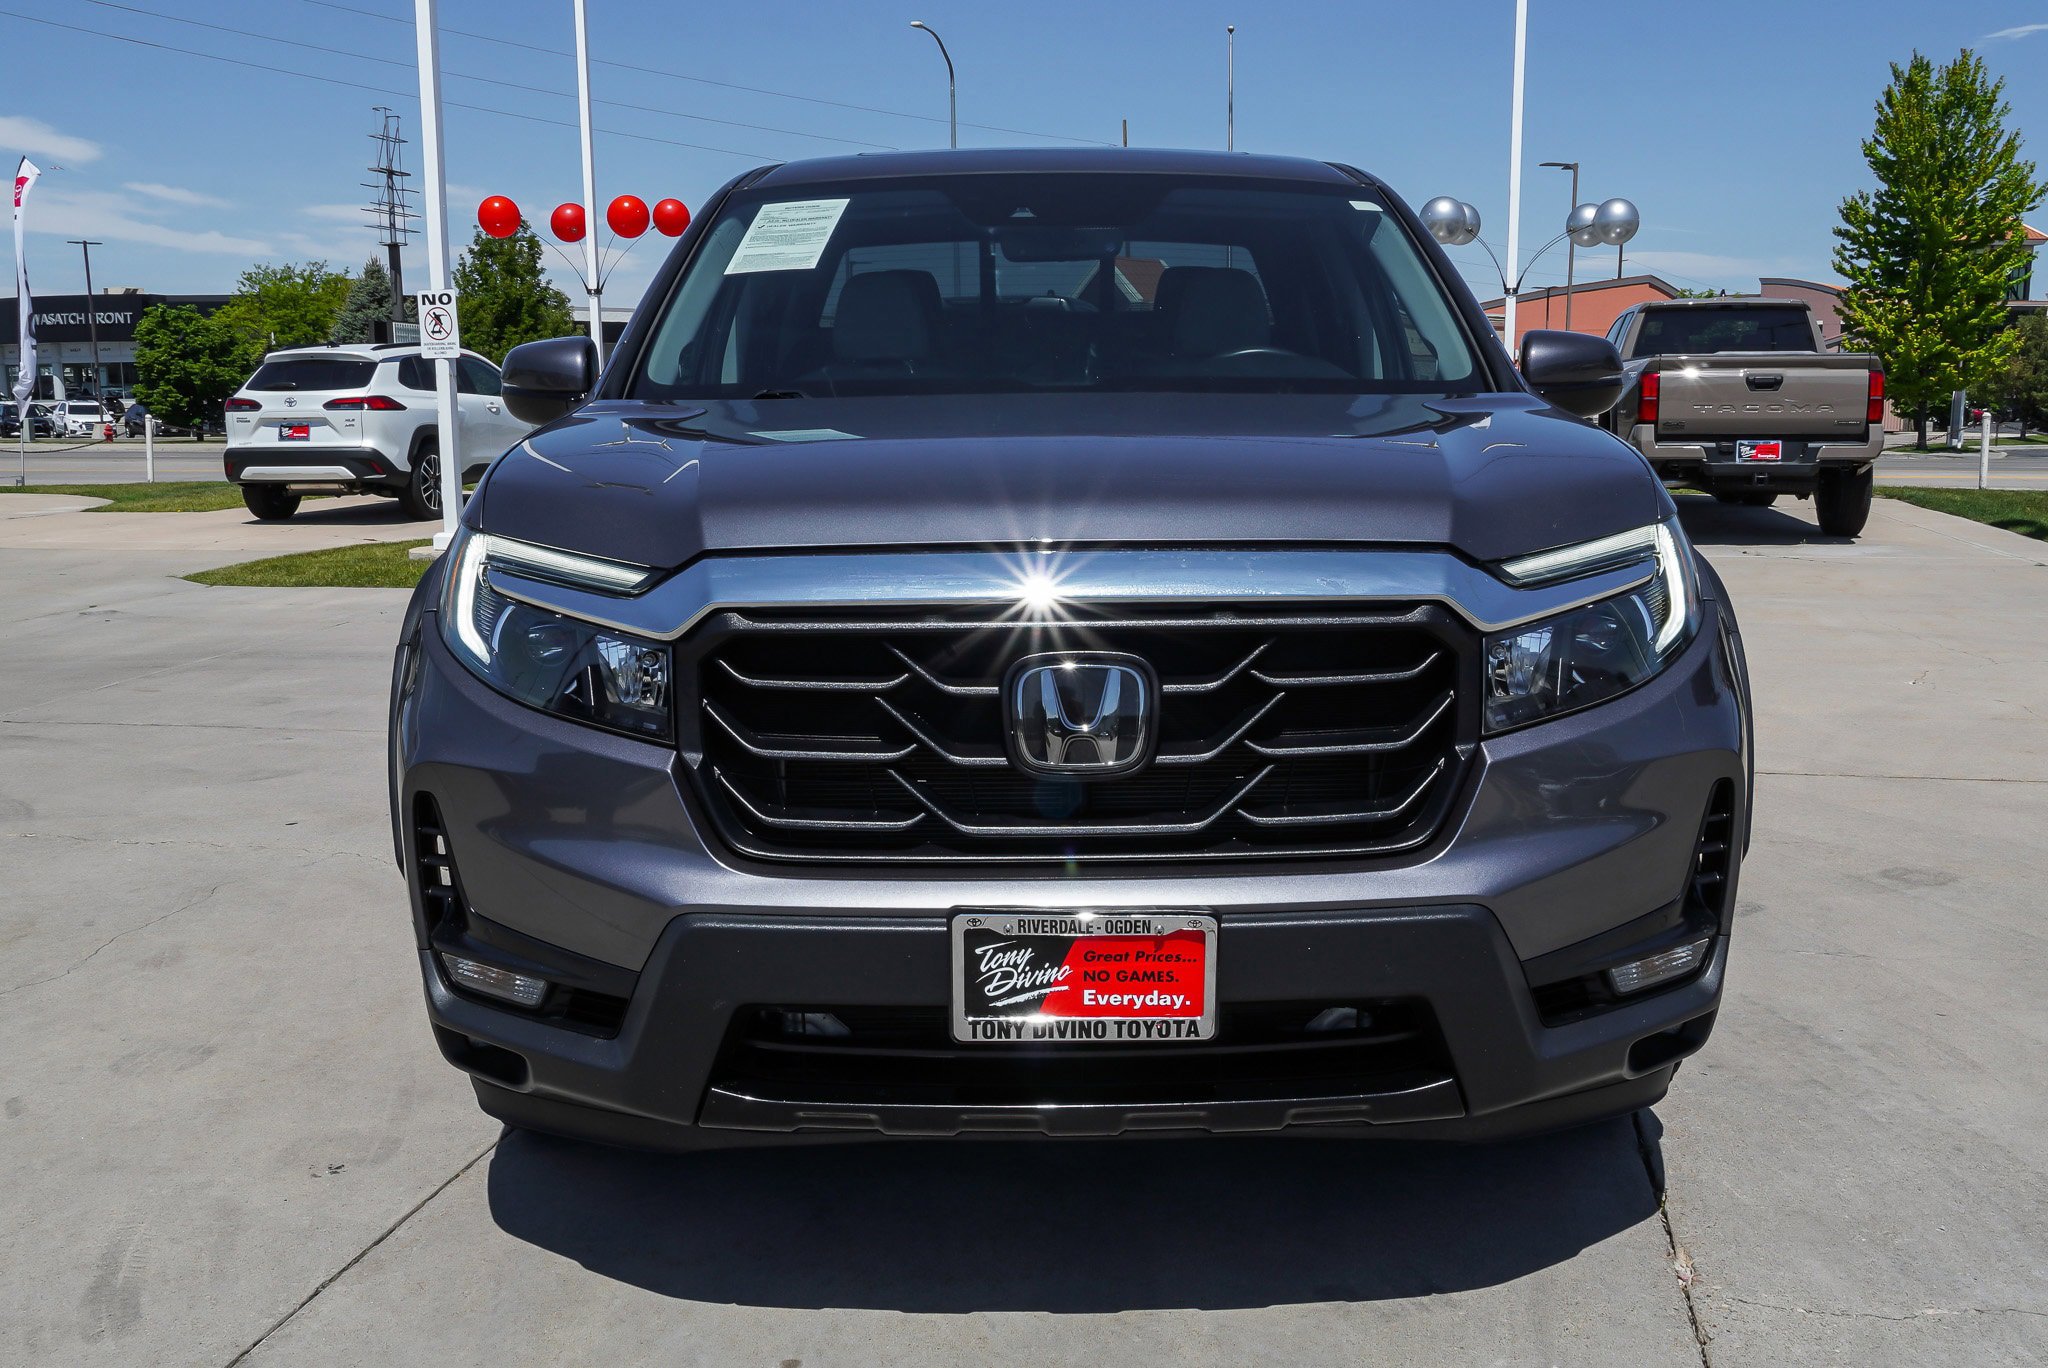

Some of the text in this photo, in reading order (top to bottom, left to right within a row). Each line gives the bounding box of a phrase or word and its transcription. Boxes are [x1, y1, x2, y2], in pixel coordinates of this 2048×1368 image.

[421, 293, 452, 305] NO
[1693, 404, 1835, 413] TACOMA
[1017, 919, 1094, 935] RIVERDALE
[1104, 919, 1151, 934] OGDEN
[975, 940, 1035, 972] Tony
[1083, 950, 1198, 963] Great Prices...
[975, 964, 1073, 996] Divino
[1083, 970, 1180, 983] NO GAMES.
[1083, 989, 1191, 1010] Everyday.
[968, 1020, 1201, 1039] TONY DIVINO TOYOTA
